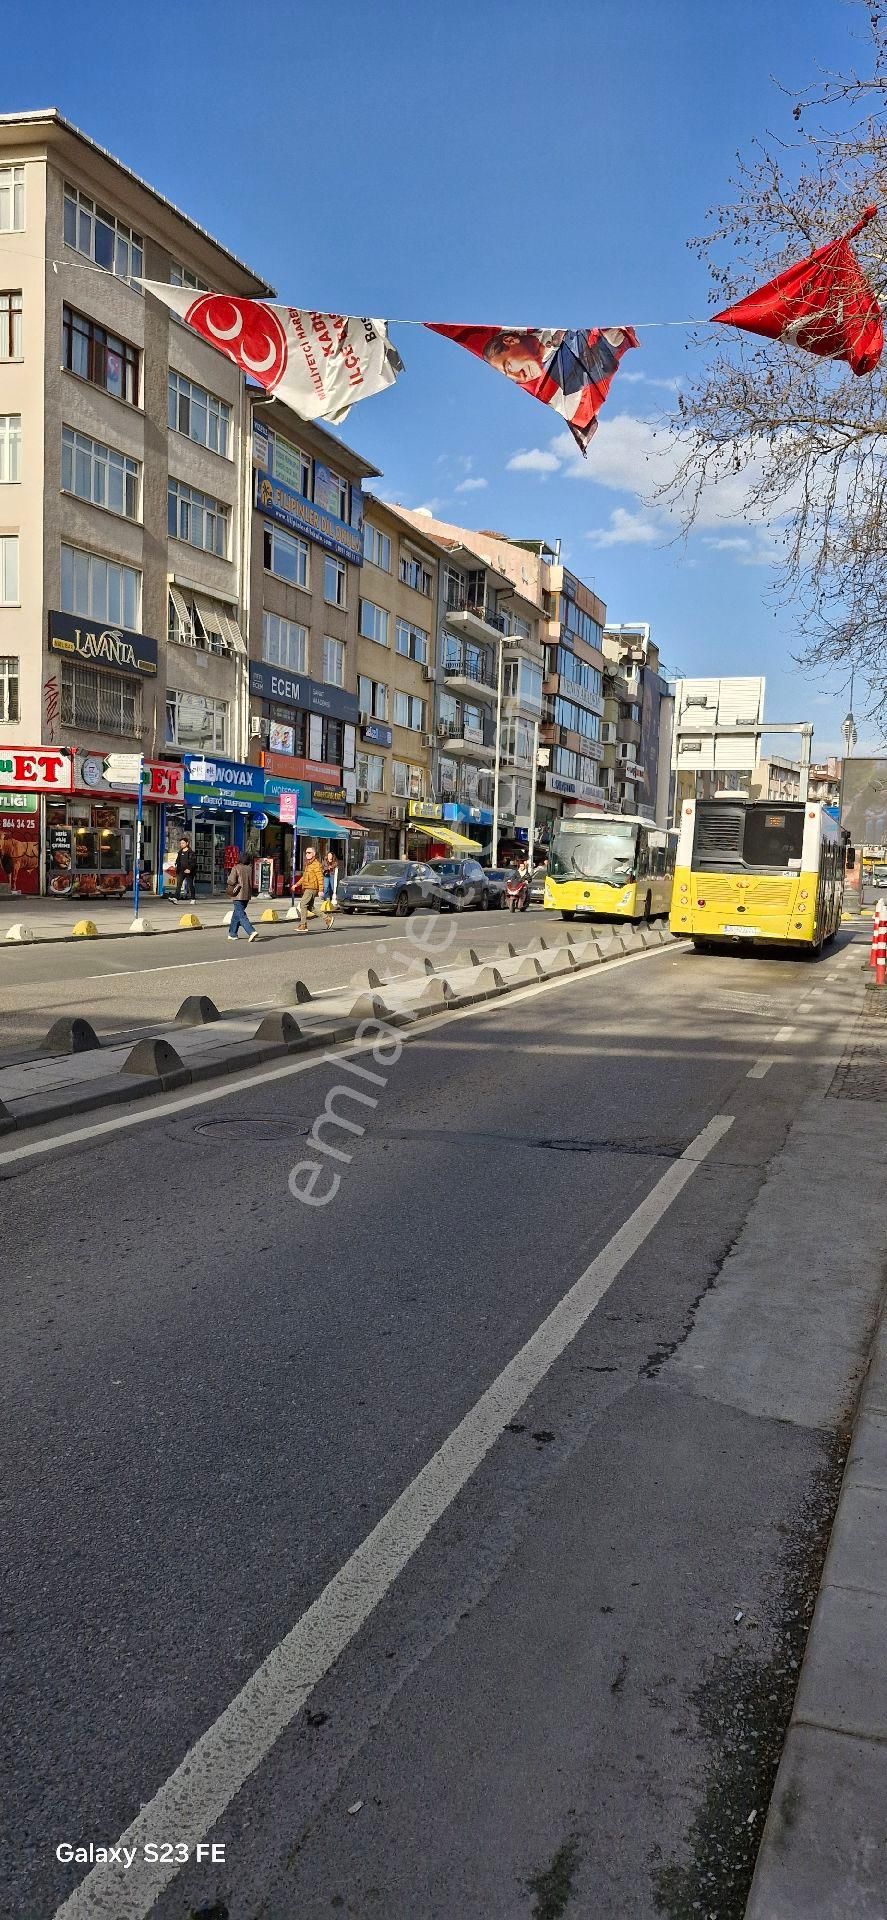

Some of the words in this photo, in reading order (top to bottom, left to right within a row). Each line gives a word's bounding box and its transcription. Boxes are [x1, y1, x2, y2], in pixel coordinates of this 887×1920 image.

[75, 629, 138, 668] LAVANTA
[271, 676, 300, 700] ECEM
[16, 819, 25, 829] 34
[26, 819, 36, 829] 25
